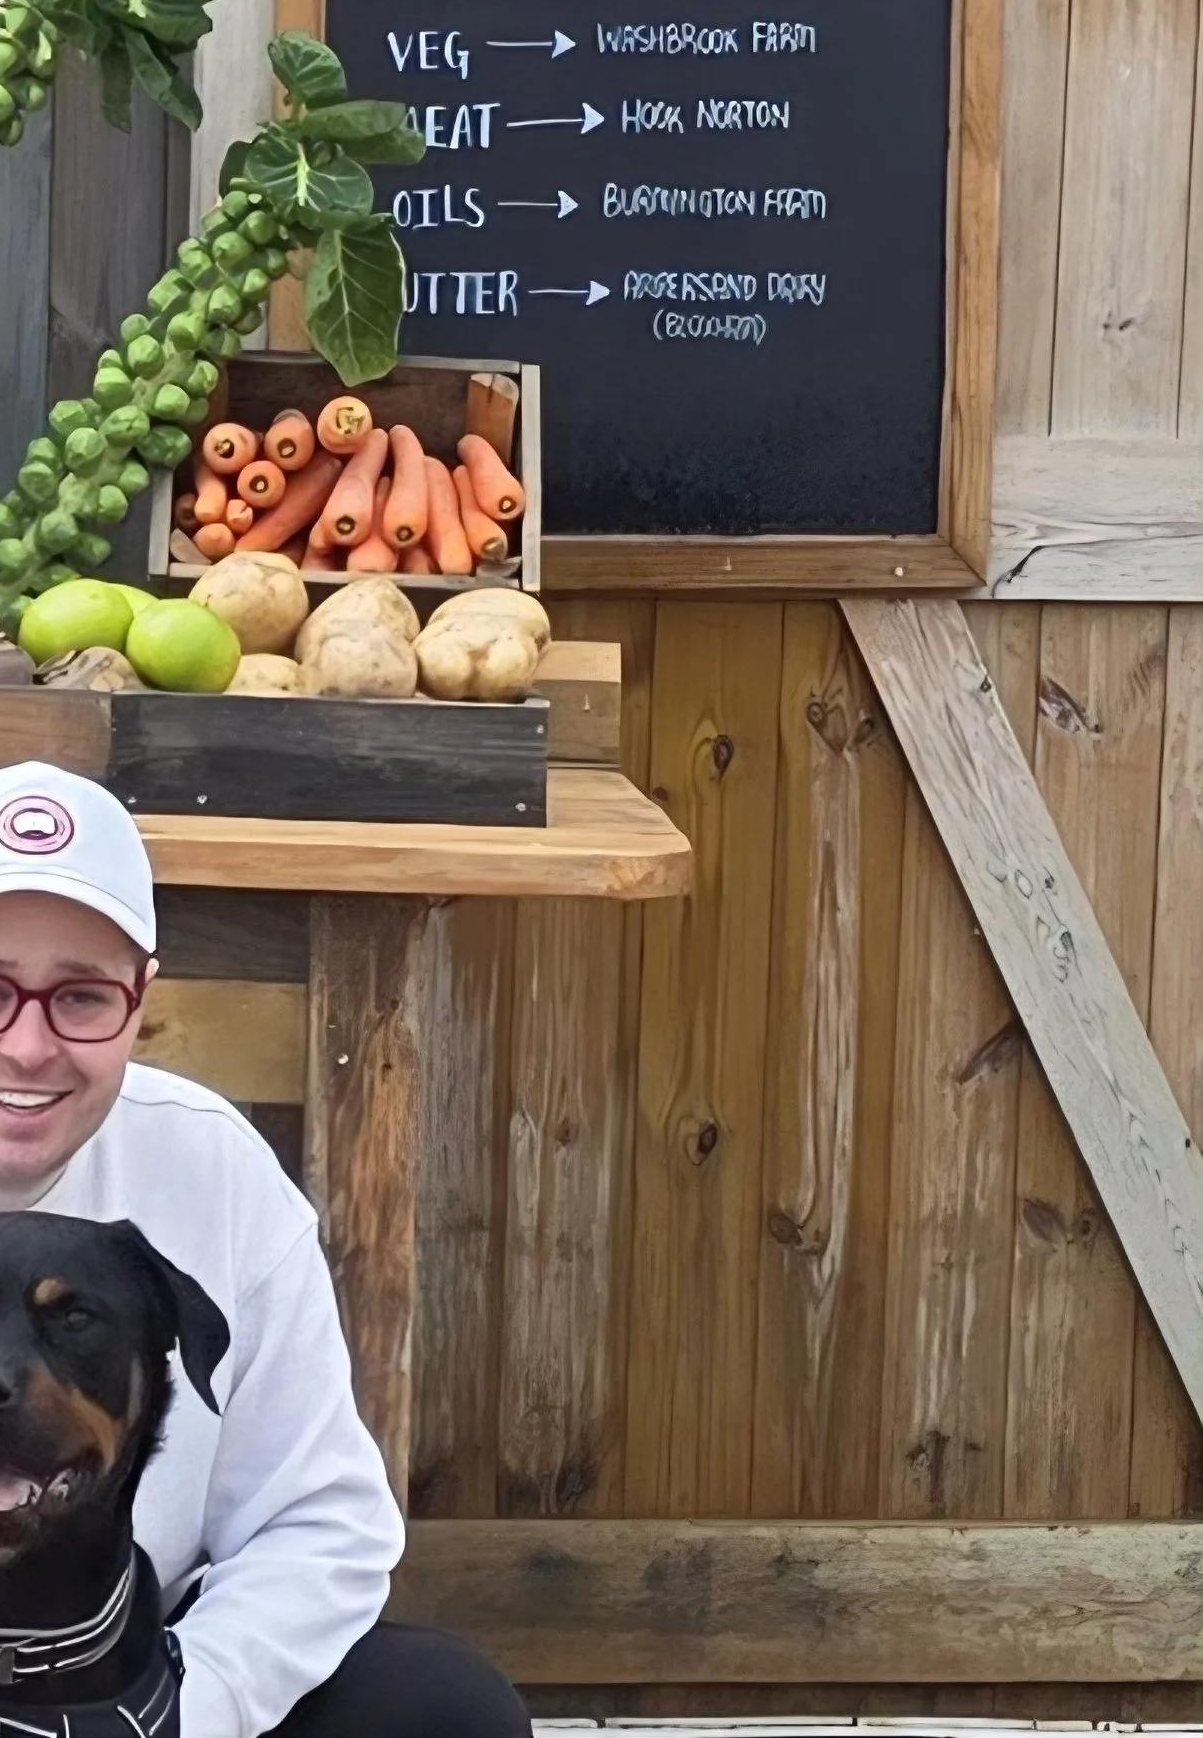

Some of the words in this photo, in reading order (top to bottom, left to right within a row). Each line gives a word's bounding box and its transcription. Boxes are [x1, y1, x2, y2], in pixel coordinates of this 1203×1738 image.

[387, 30, 469, 80] VEG
[752, 22, 816, 53] FARM
[697, 99, 790, 129] NORTON
[392, 183, 485, 231] OILS
[408, 269, 519, 317] UTTER
